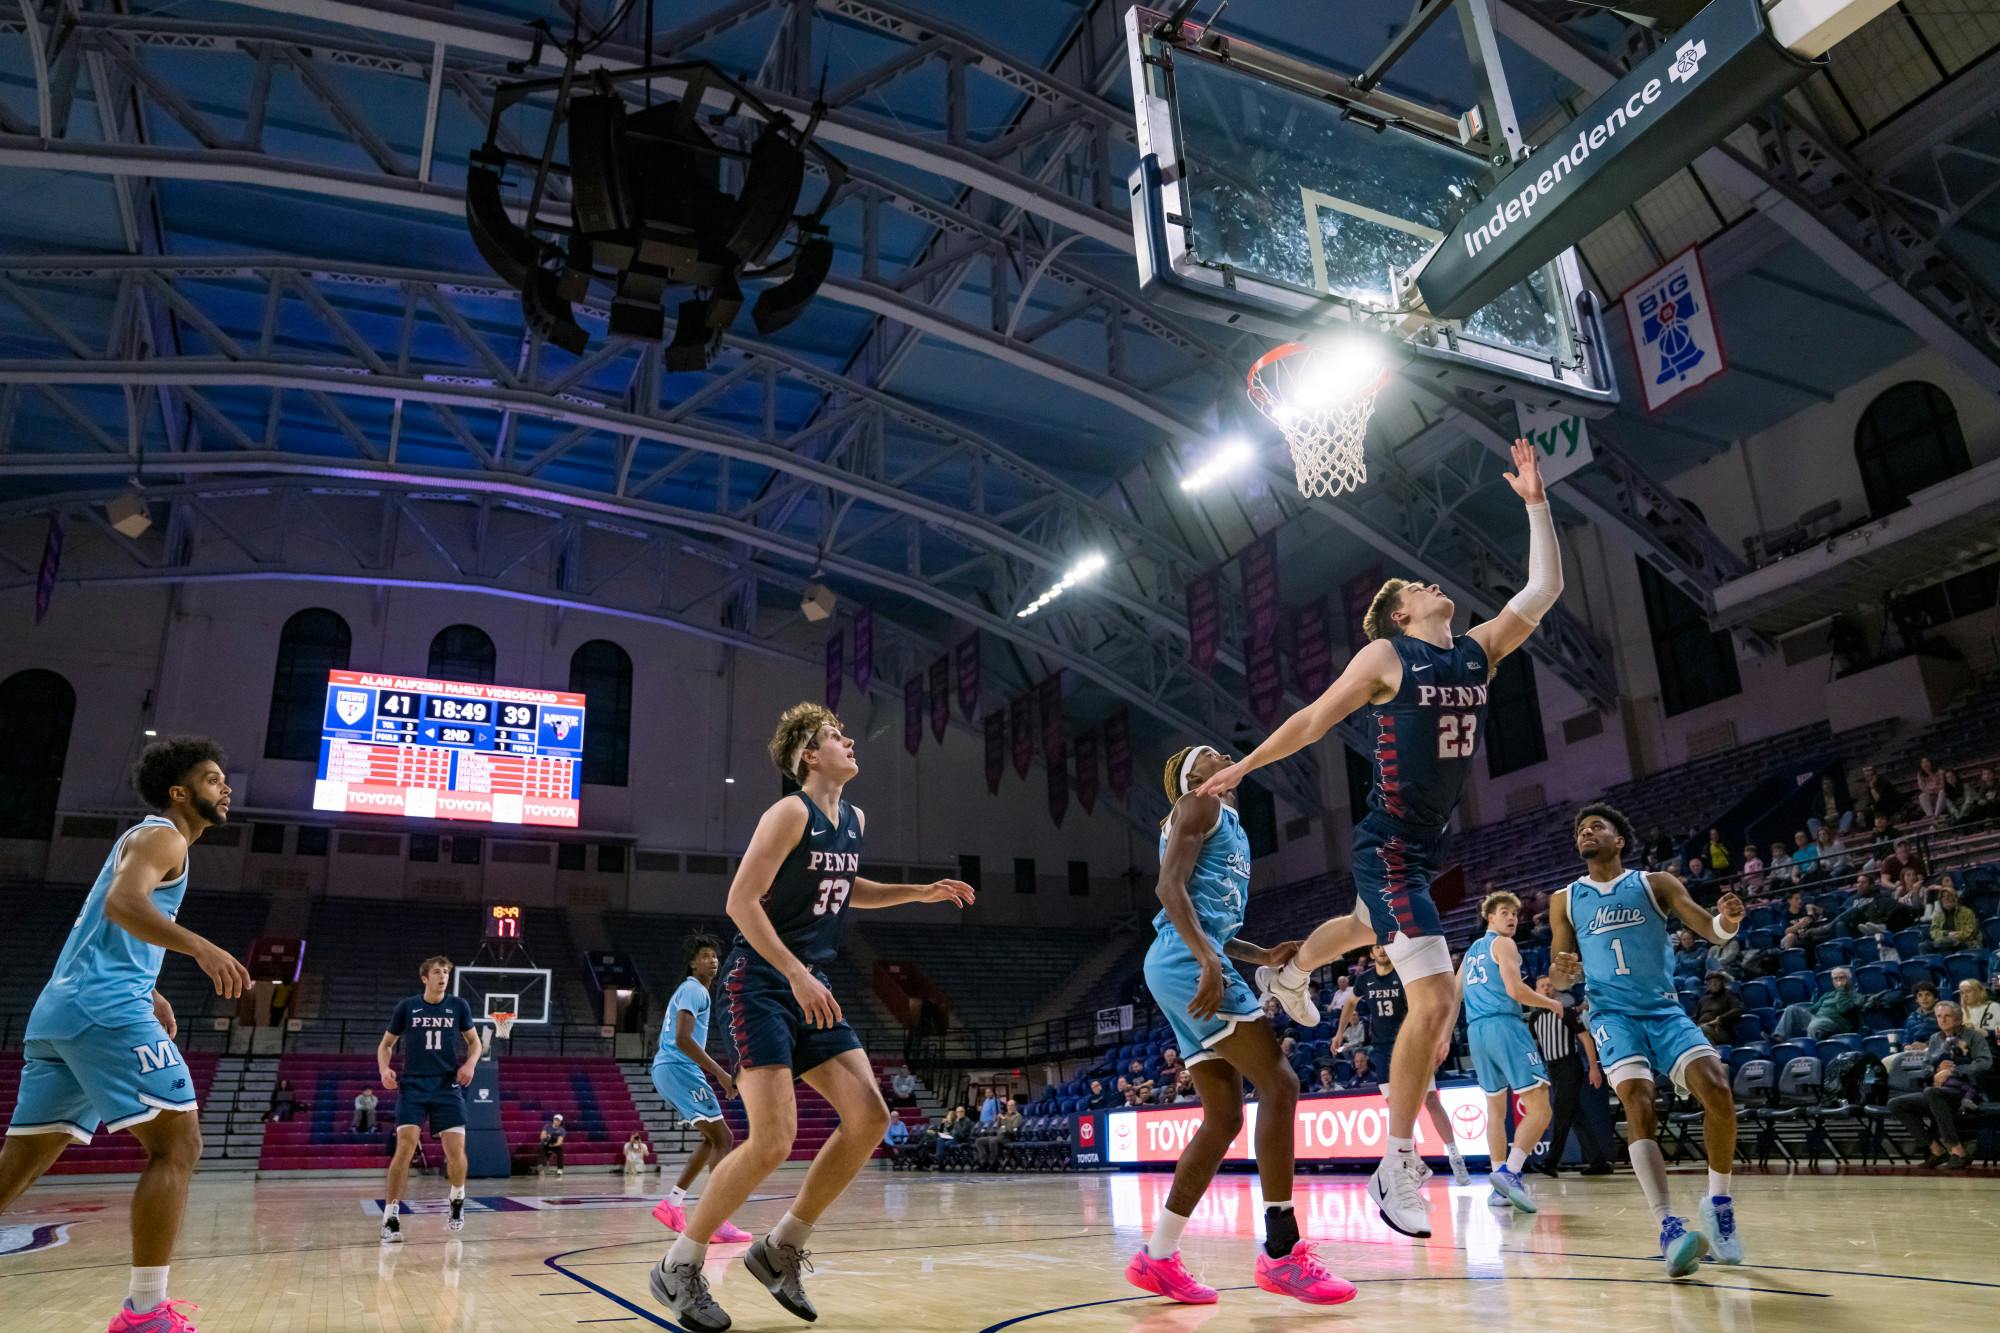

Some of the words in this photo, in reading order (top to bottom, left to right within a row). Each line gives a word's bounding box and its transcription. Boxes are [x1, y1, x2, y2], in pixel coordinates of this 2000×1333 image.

[1464, 77, 1662, 258] Independence
[1638, 273, 1689, 318] BIG
[360, 675, 393, 688] ALAN
[445, 683, 484, 697] FAMILY
[486, 687, 558, 703] VIDEOBOARD
[1417, 683, 1488, 707] PENN
[384, 695, 410, 714] 41
[432, 699, 487, 721] 18:49
[503, 706, 531, 726] 39
[406, 722, 414, 731] 3
[442, 728, 471, 742] 2ND
[500, 730, 507, 739] 3
[1438, 713, 1478, 758] 23
[376, 732, 398, 742] FOULS
[405, 734, 413, 743] 0
[500, 742, 506, 752] 1
[511, 744, 534, 754] FOULS
[347, 791, 404, 806] TOYOTA
[438, 797, 492, 813] TOYOTA
[524, 804, 577, 818] TOYOTA
[807, 851, 860, 872] PENN
[813, 879, 851, 916] 33
[498, 918, 516, 937] 17
[1588, 903, 1646, 934] Maine
[1610, 938, 1631, 976] 1
[1466, 953, 1489, 986] 25
[1368, 988, 1400, 999] PENN
[1376, 1000, 1394, 1017] 13
[411, 1017, 455, 1028] PENN
[425, 1030, 443, 1051] 11
[131, 1040, 181, 1075] M
[689, 1087, 710, 1103] M
[1077, 1153, 1099, 1164] TOYOTA
